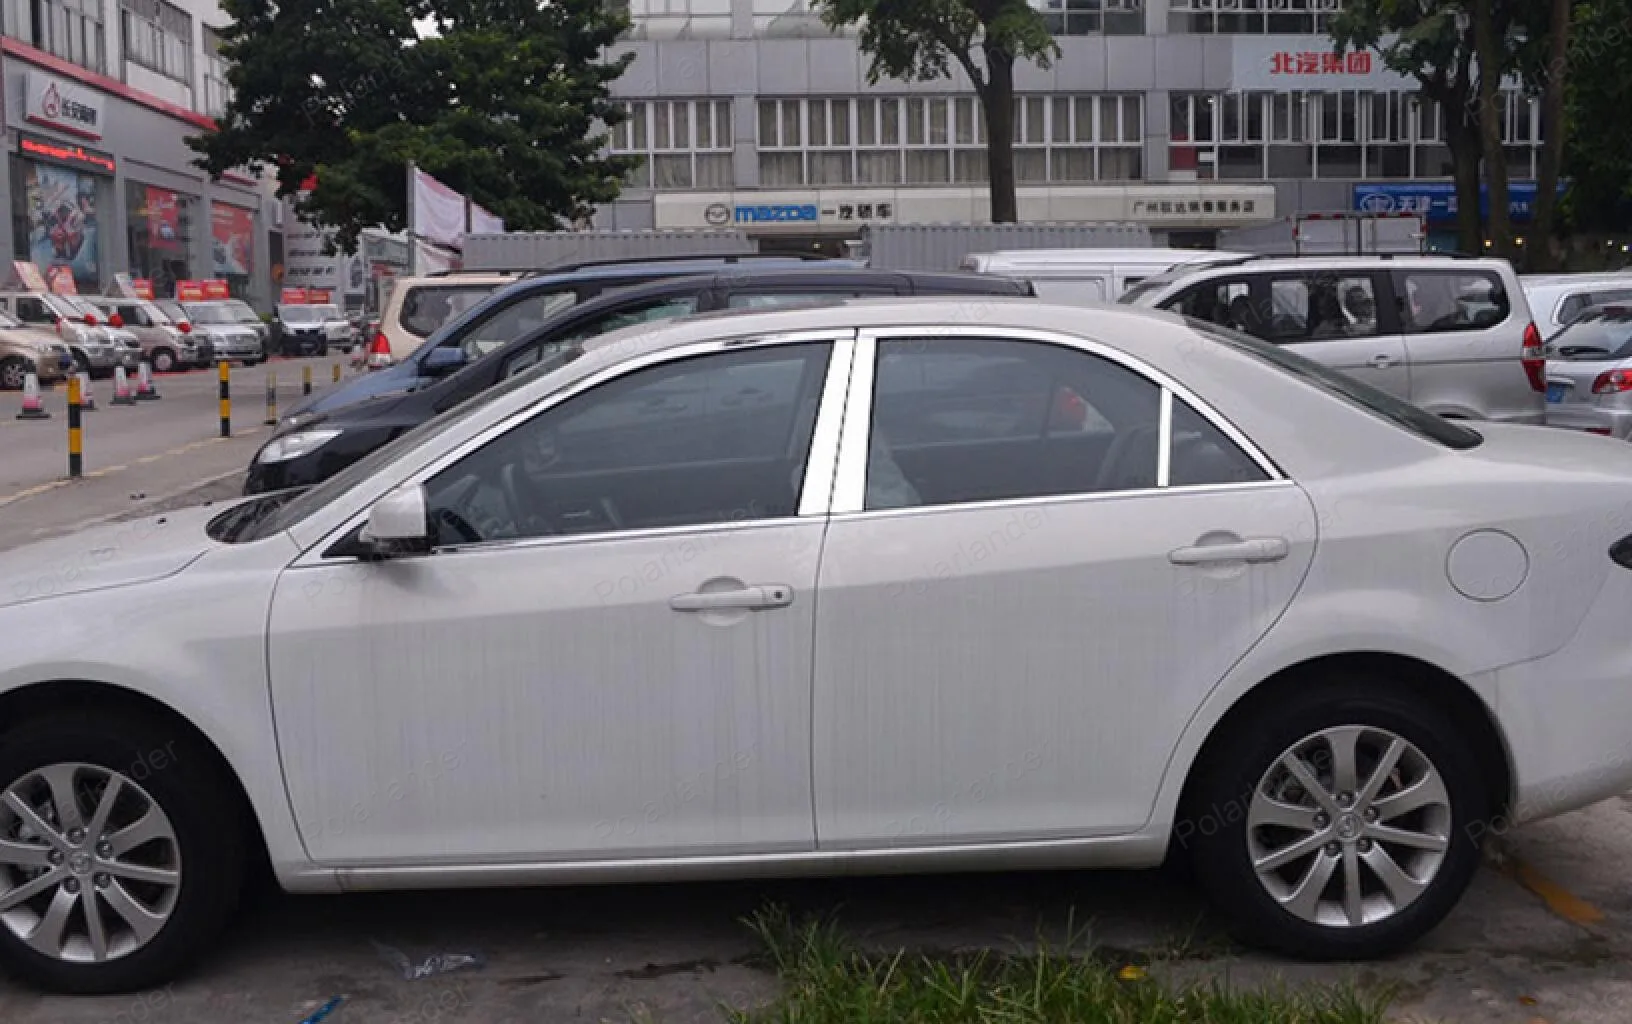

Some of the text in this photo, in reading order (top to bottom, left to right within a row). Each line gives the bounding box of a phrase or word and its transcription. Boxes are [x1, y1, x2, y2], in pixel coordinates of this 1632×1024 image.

[1270, 50, 1371, 75] 北汽集团
[735, 205, 818, 222] mazda
